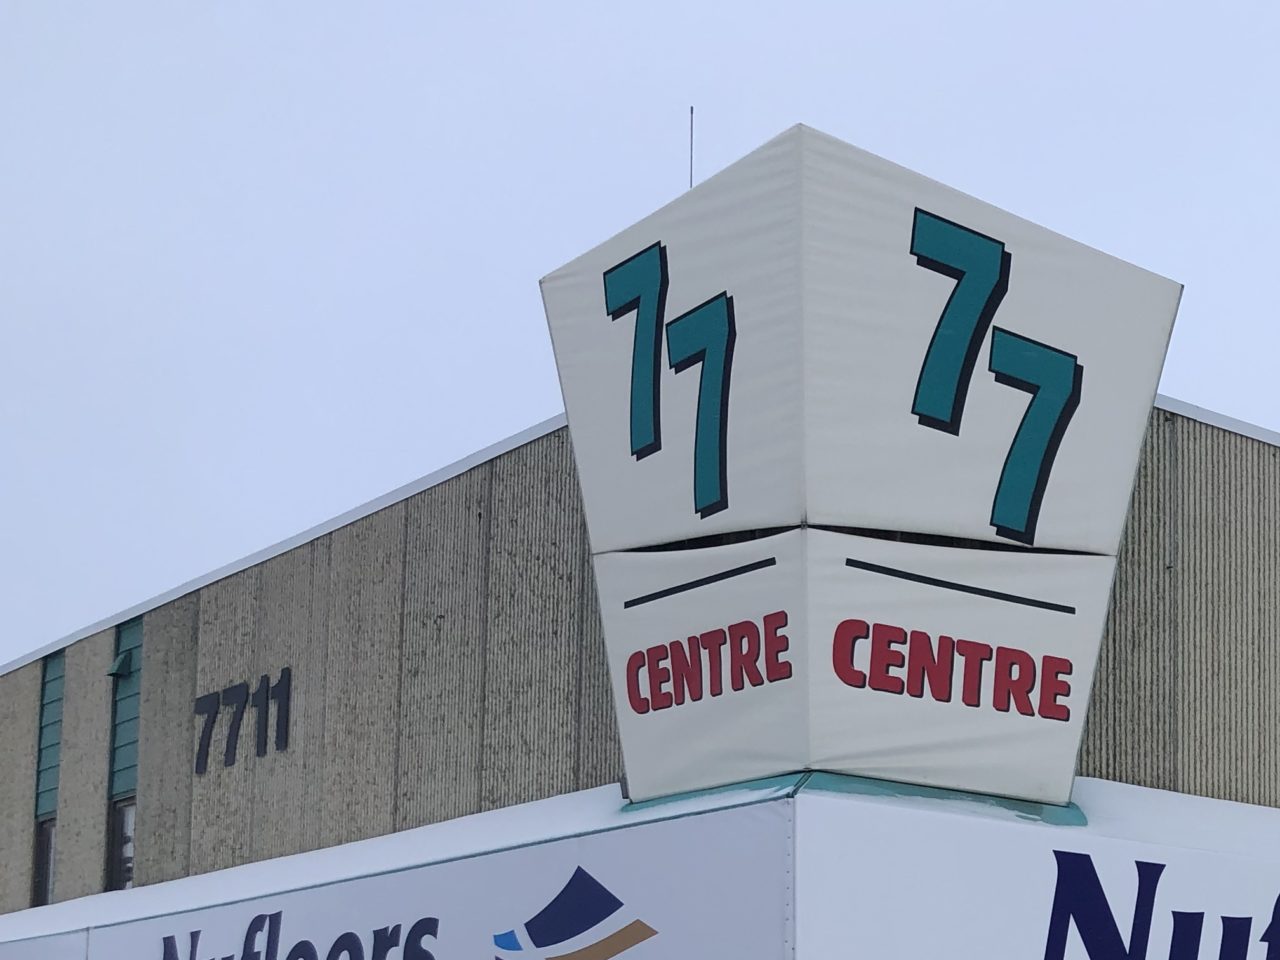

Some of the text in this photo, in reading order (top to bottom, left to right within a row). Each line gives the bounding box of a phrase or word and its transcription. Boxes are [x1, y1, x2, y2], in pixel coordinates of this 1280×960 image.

[603, 240, 737, 520] 77
[910, 206, 1084, 546] 77
[624, 610, 793, 715] CENTRE
[832, 617, 1073, 722] CENTRE
[194, 667, 292, 774] 7711
